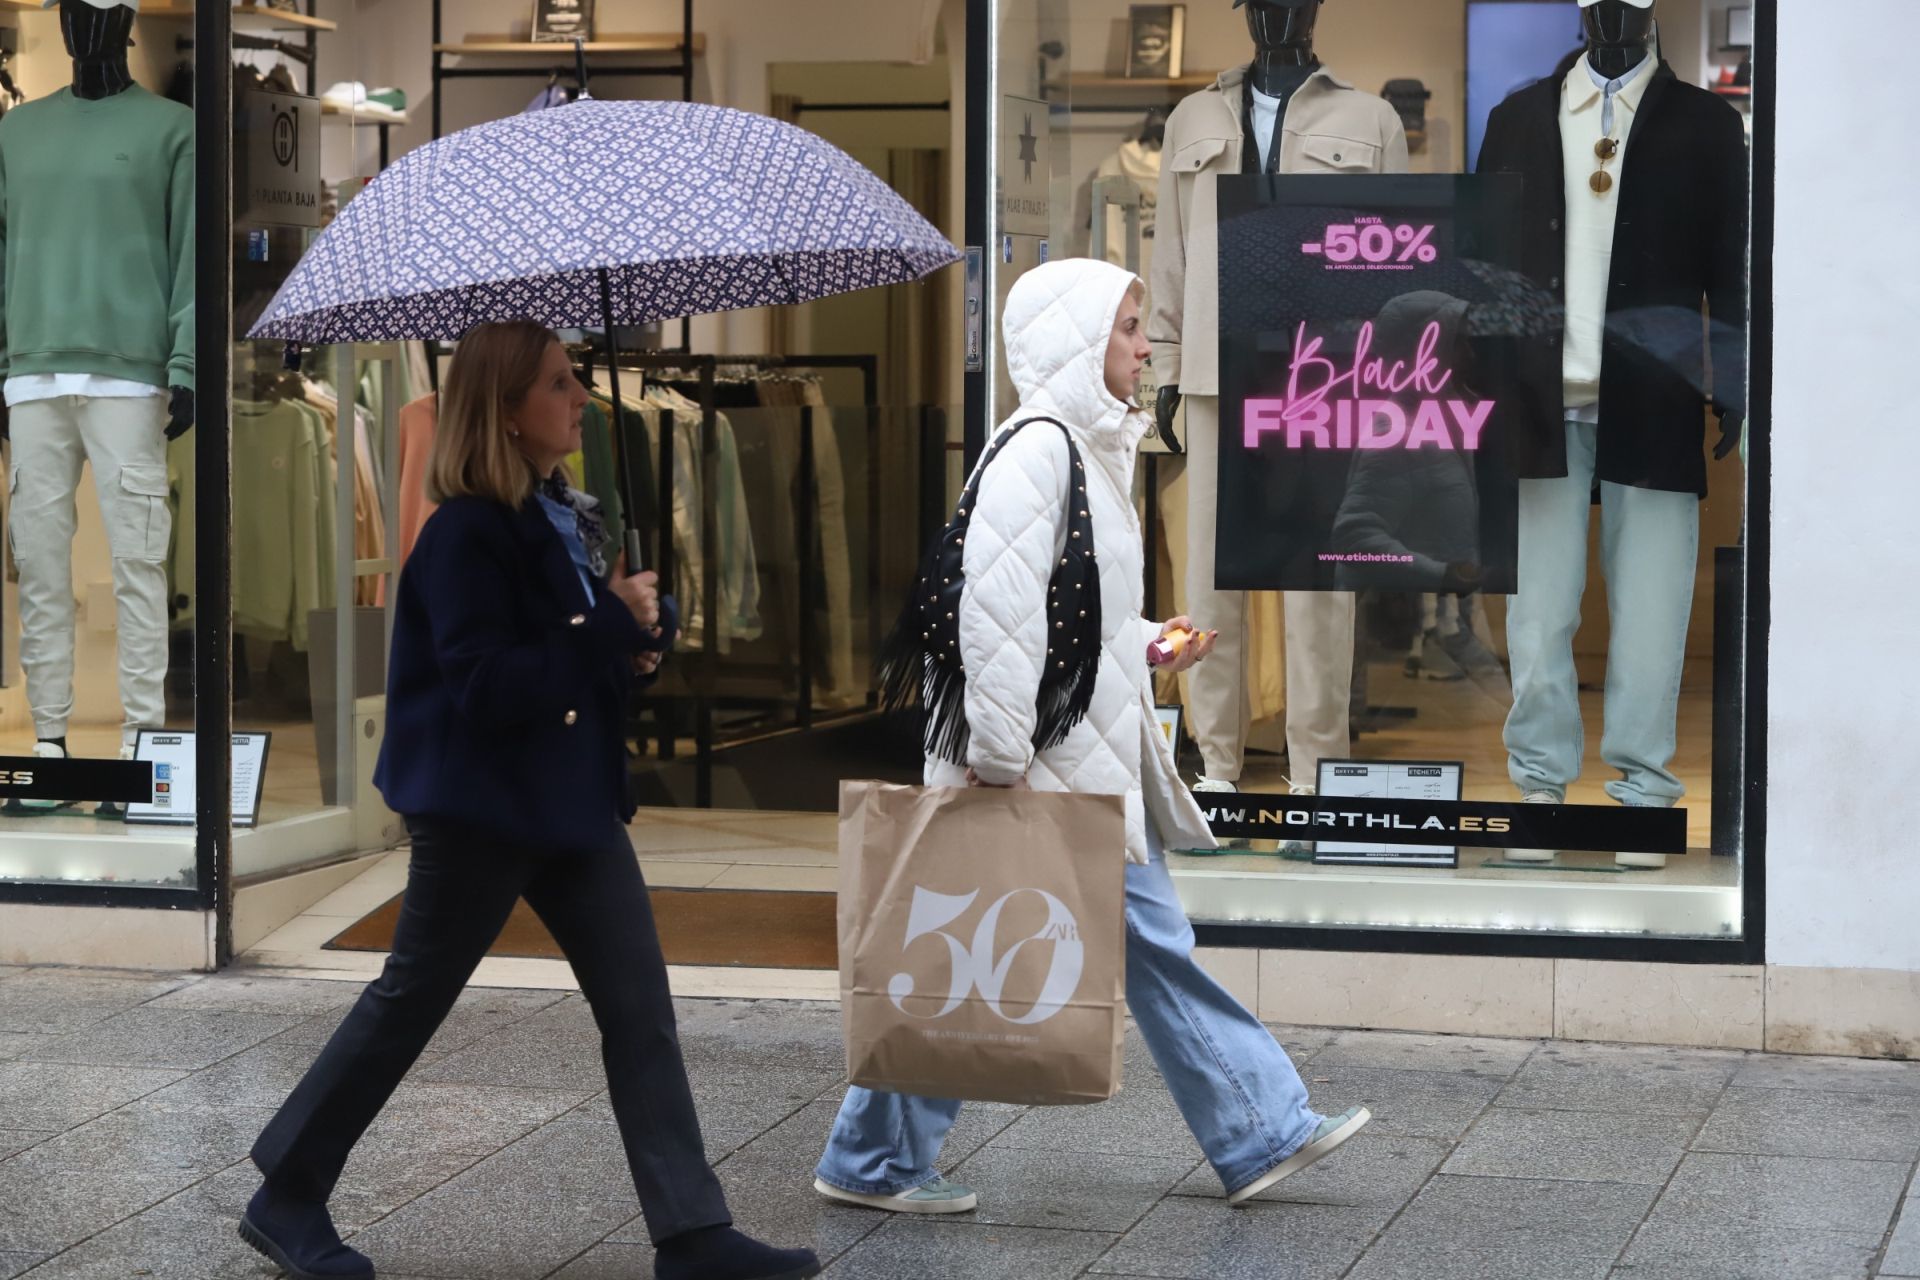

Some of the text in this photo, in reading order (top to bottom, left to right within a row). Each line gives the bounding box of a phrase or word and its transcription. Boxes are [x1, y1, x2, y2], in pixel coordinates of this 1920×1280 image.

[296, 192, 316, 207] BAJA
[1302, 224, 1437, 262] -50%
[1282, 321, 1452, 420] Black
[1244, 399, 1495, 449] FRIDAY
[1318, 553, 1413, 562] www.etichetta.es
[888, 884, 1084, 1025] 50
